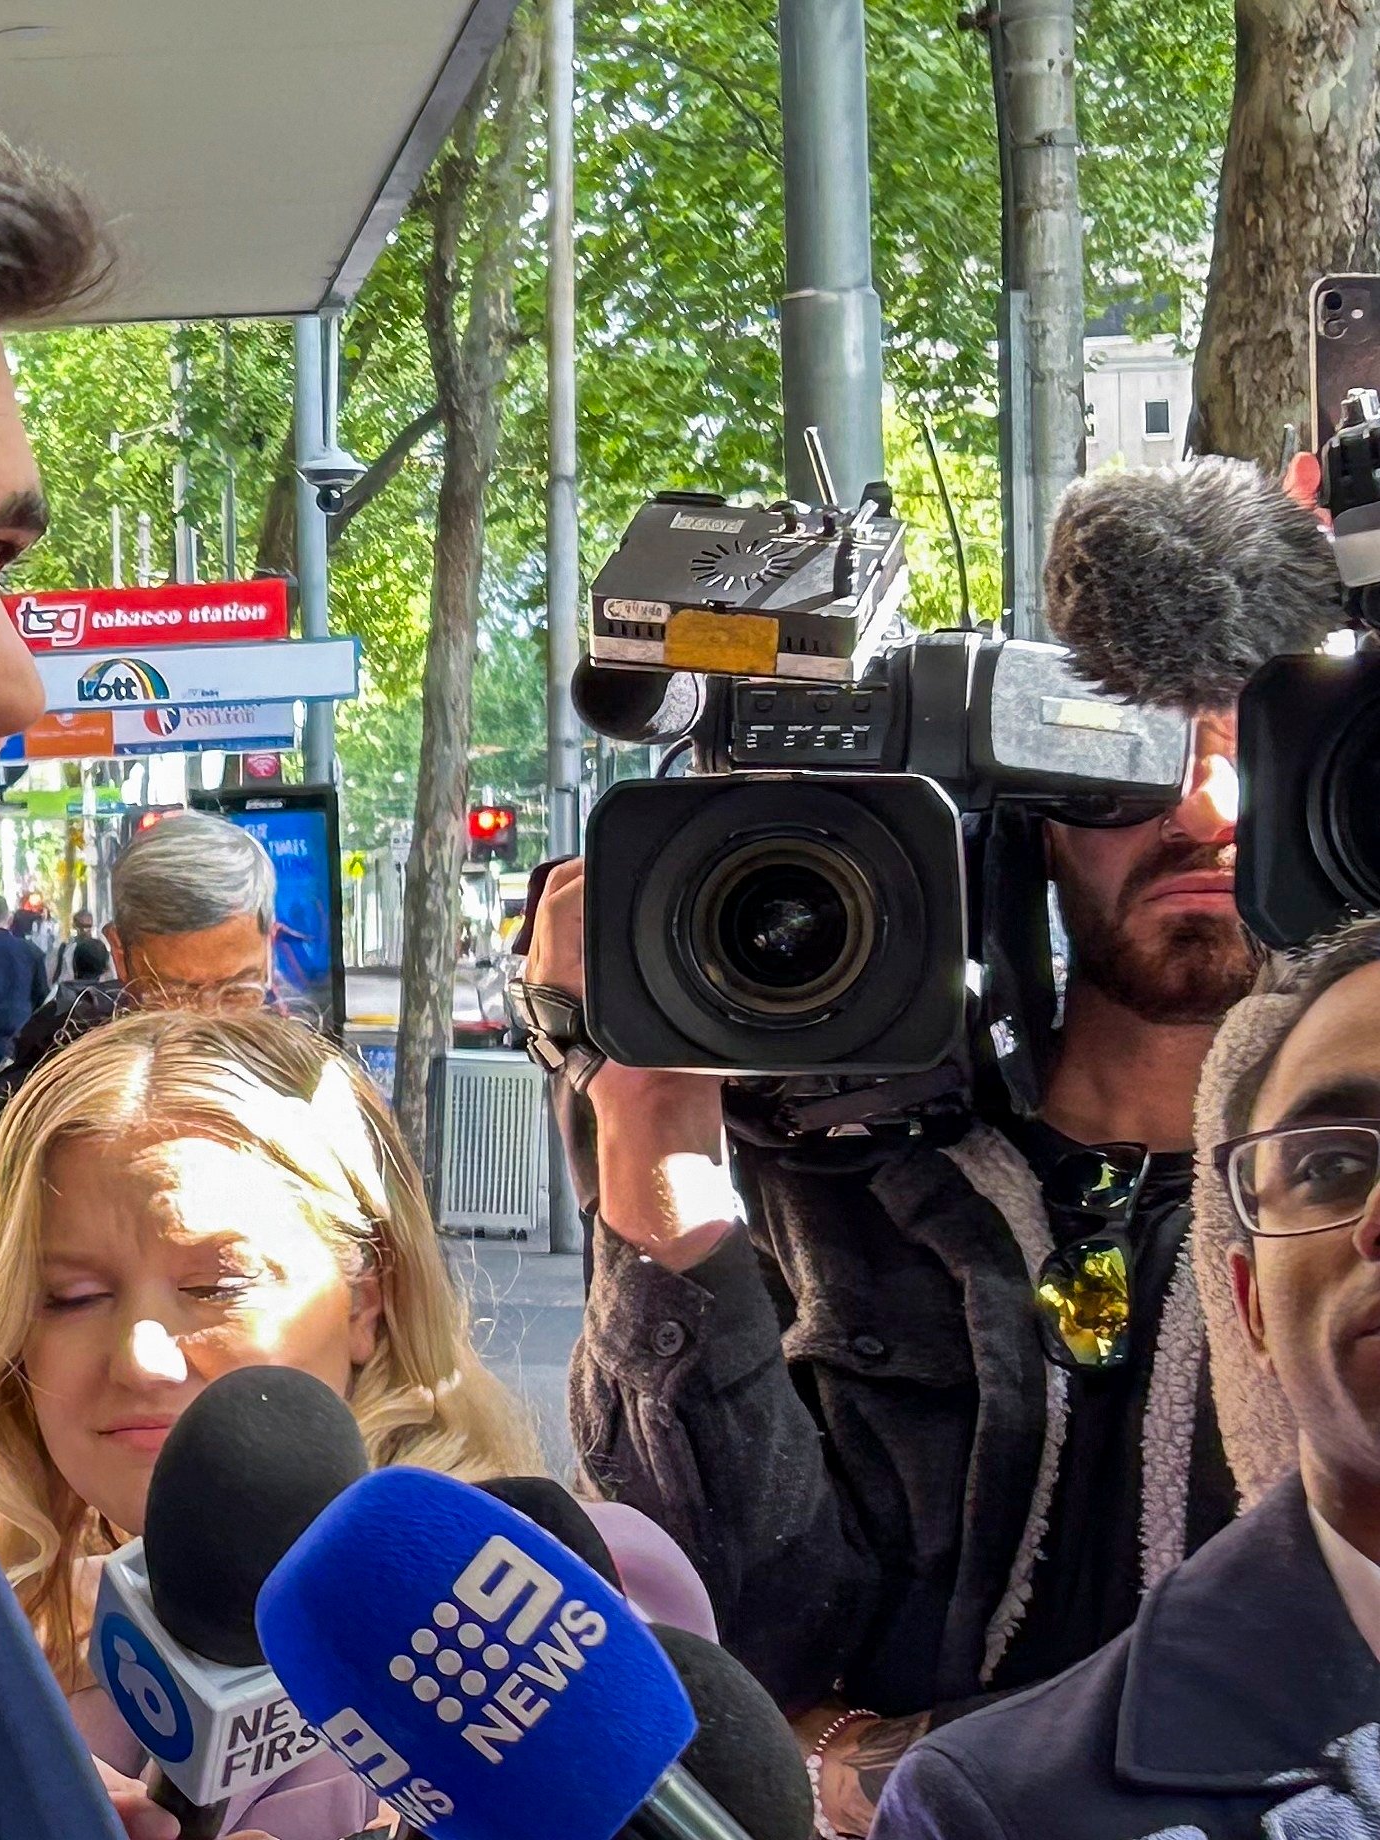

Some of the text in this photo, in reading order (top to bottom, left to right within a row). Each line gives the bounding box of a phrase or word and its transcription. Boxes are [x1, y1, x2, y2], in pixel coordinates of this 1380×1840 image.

[92, 607, 182, 628] tobacco
[188, 602, 268, 624] station
[461, 1600, 607, 1764] NEWS
[227, 1697, 291, 1750] NE
[220, 1724, 320, 1788] FIRS
[384, 1777, 455, 1830] WS
